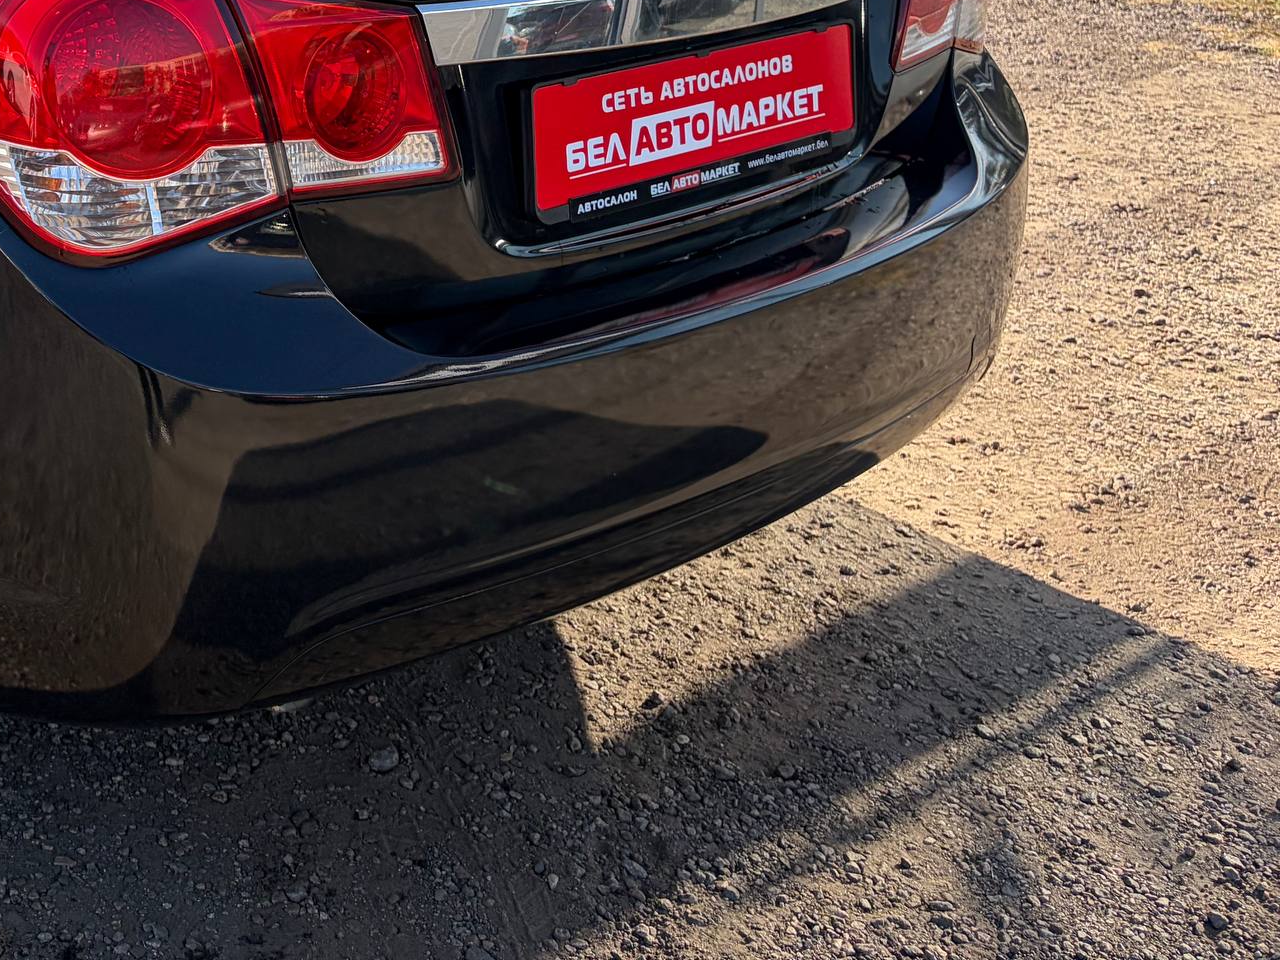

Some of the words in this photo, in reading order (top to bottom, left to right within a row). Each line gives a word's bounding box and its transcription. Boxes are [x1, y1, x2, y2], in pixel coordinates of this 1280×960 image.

[601, 86, 654, 114] СЕТЬ
[659, 54, 793, 102] АВТОСАЛОНОВ
[577, 189, 638, 215] АВТОСАЛОН
